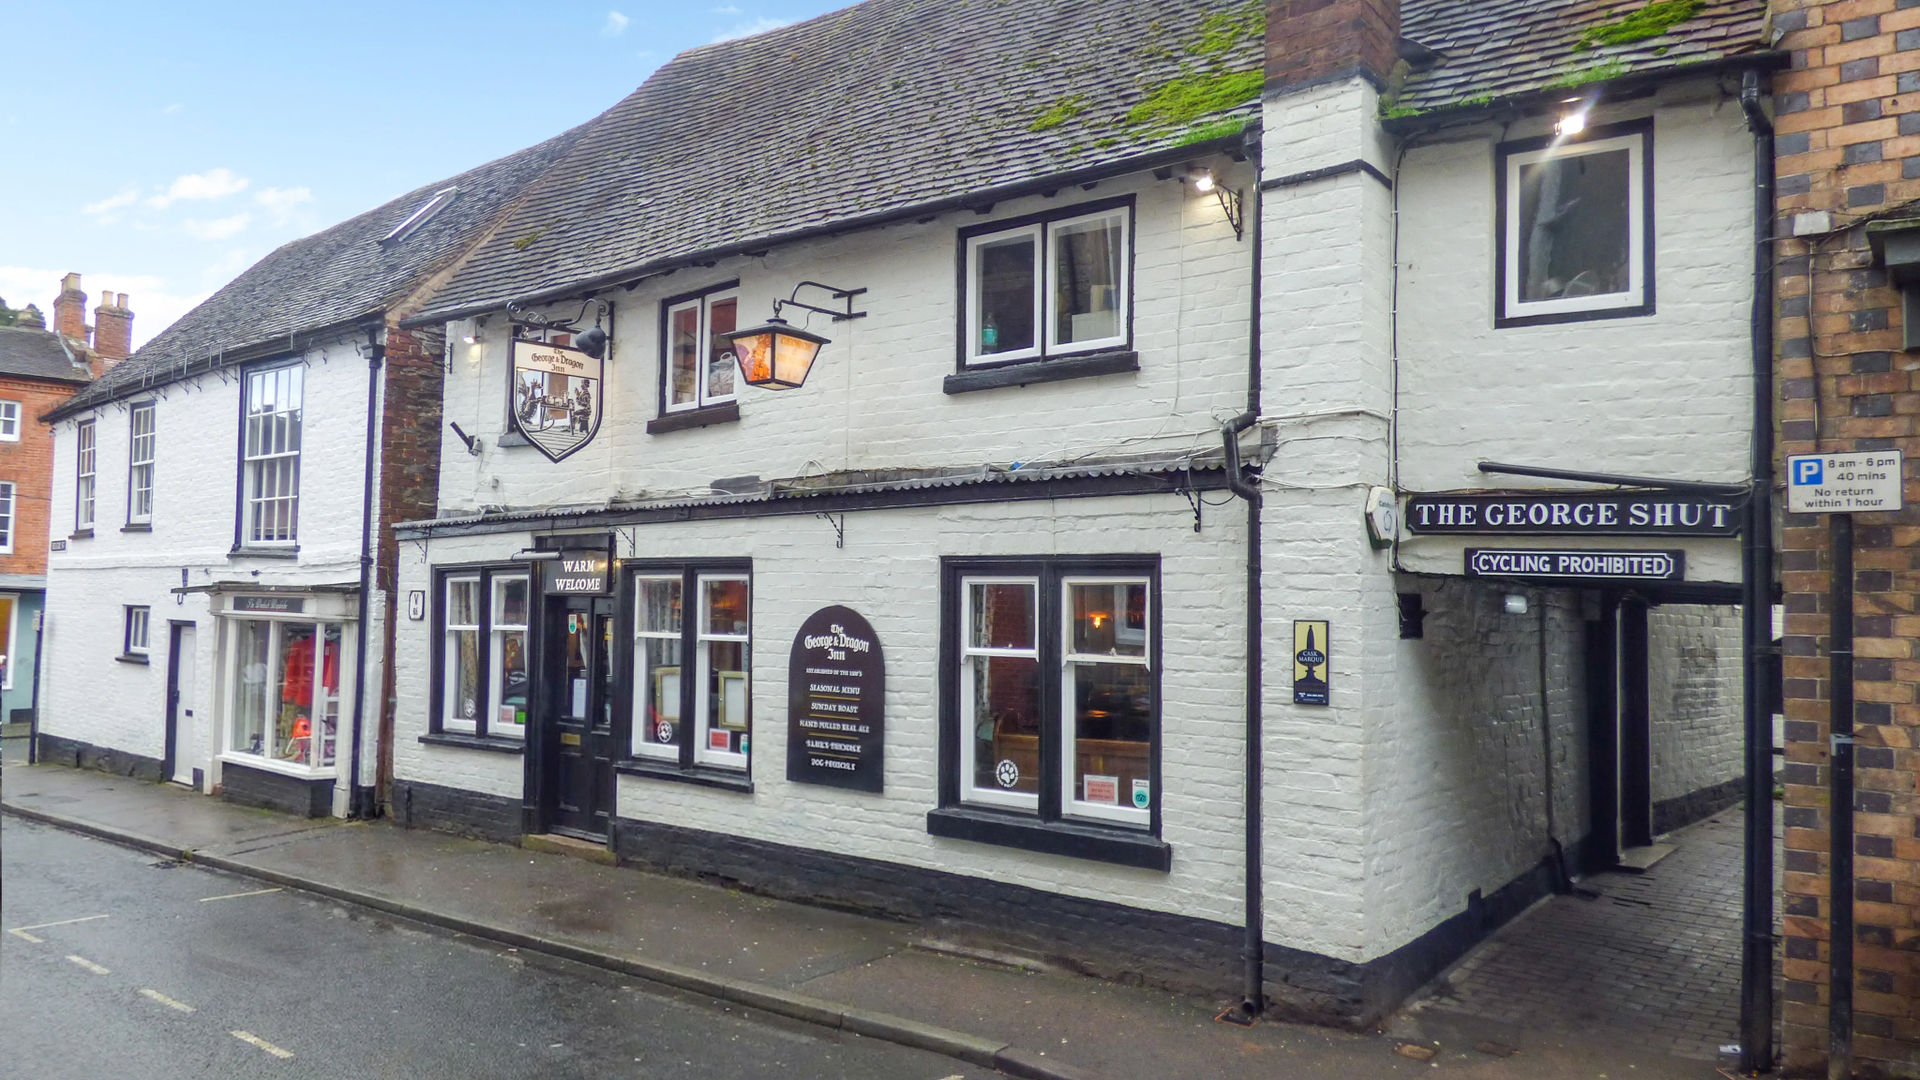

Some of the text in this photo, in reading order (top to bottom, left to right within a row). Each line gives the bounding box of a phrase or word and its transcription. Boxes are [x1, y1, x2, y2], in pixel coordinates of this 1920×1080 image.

[531, 353, 555, 364] George
[560, 355, 584, 370] Dragon
[551, 364, 565, 372] Inn
[1828, 460, 1835, 468] 8
[1866, 458, 1874, 466] 6
[1877, 458, 1895, 467] pm
[1800, 462, 1818, 484] P
[1837, 472, 1886, 481] 40 mins
[1814, 488, 1873, 497] No return
[1804, 499, 1841, 508] within
[1416, 503, 1731, 528] THE GEORGE SHUT
[562, 560, 595, 573] WARM
[1478, 554, 1666, 575] CYCLING PROHIBITED
[555, 578, 601, 591] WELCOME
[830, 624, 844, 635] The
[804, 633, 870, 653] George & Dragon
[827, 648, 846, 661] Inn
[809, 683, 860, 695] SEASONAL MENU
[811, 702, 859, 713] SUNDAY ROAST
[799, 719, 870, 734] HAND PULLED REAL ALE
[811, 758, 824, 767] DOG
